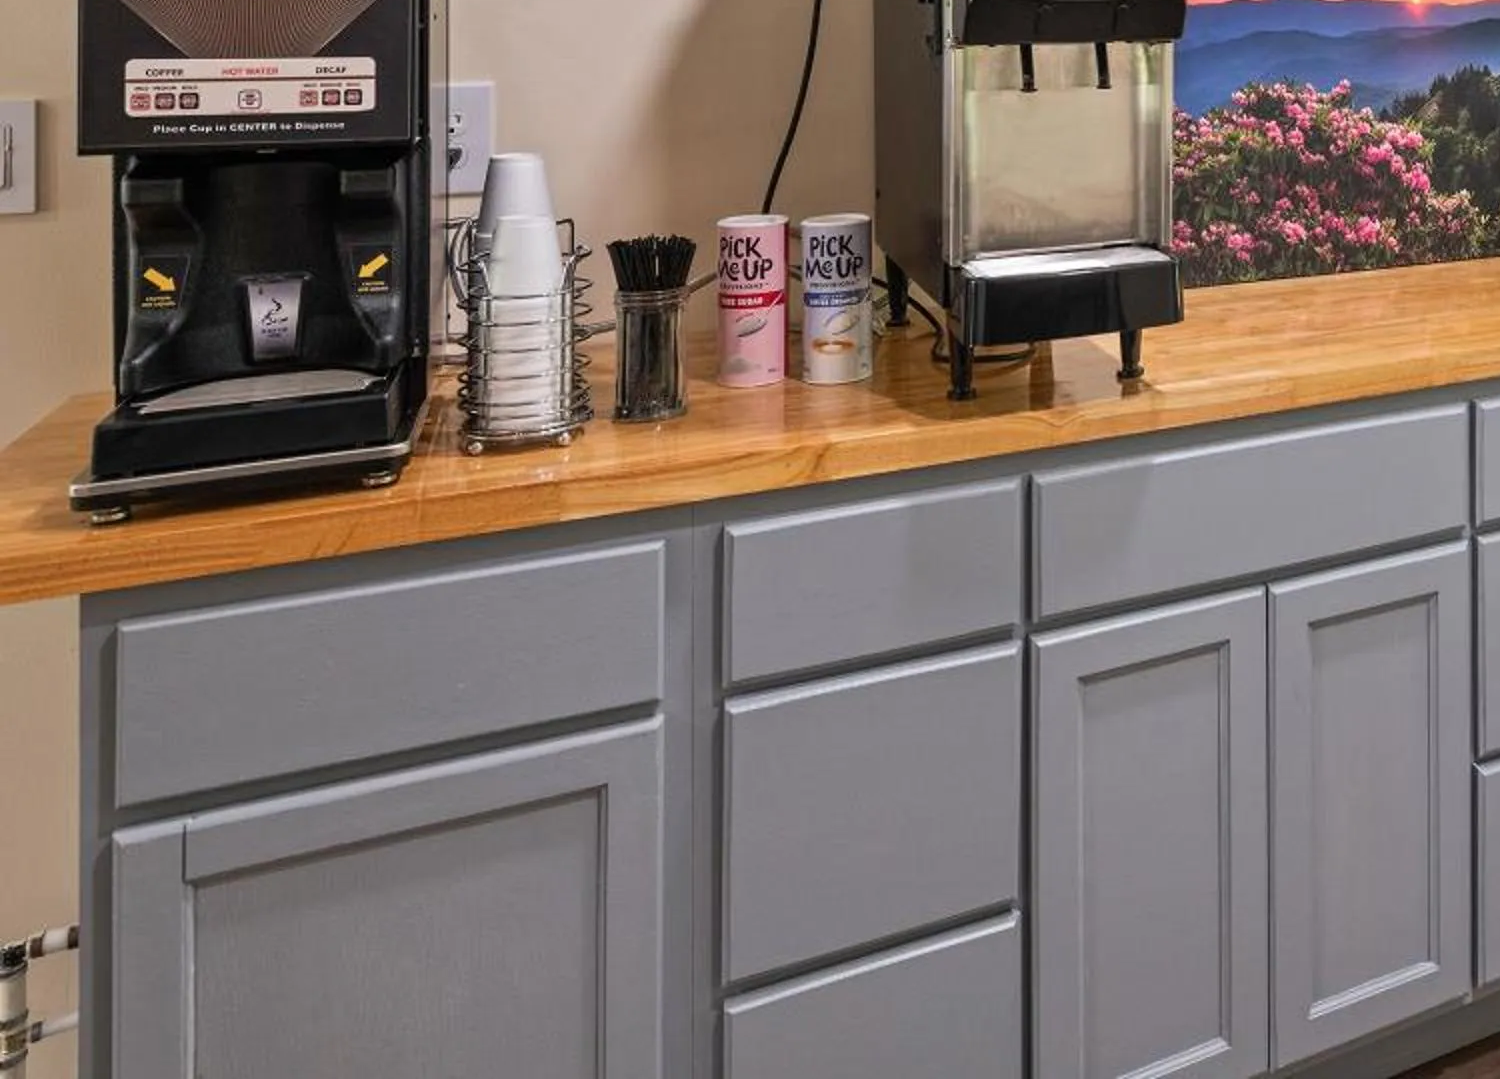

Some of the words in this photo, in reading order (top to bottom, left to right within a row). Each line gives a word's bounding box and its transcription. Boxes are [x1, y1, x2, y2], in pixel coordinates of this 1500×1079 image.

[145, 68, 184, 78] COFFEE
[221, 68, 243, 76] HOT
[245, 67, 279, 75] WATER
[315, 66, 347, 74] DECAF
[153, 124, 185, 134] Place
[189, 124, 213, 134] Cup
[215, 124, 227, 132] in
[229, 122, 277, 132] CENTER
[295, 121, 345, 131] Dispense
[743, 259, 773, 281] UP
[805, 259, 833, 281] Me
[836, 256, 864, 278] UP
